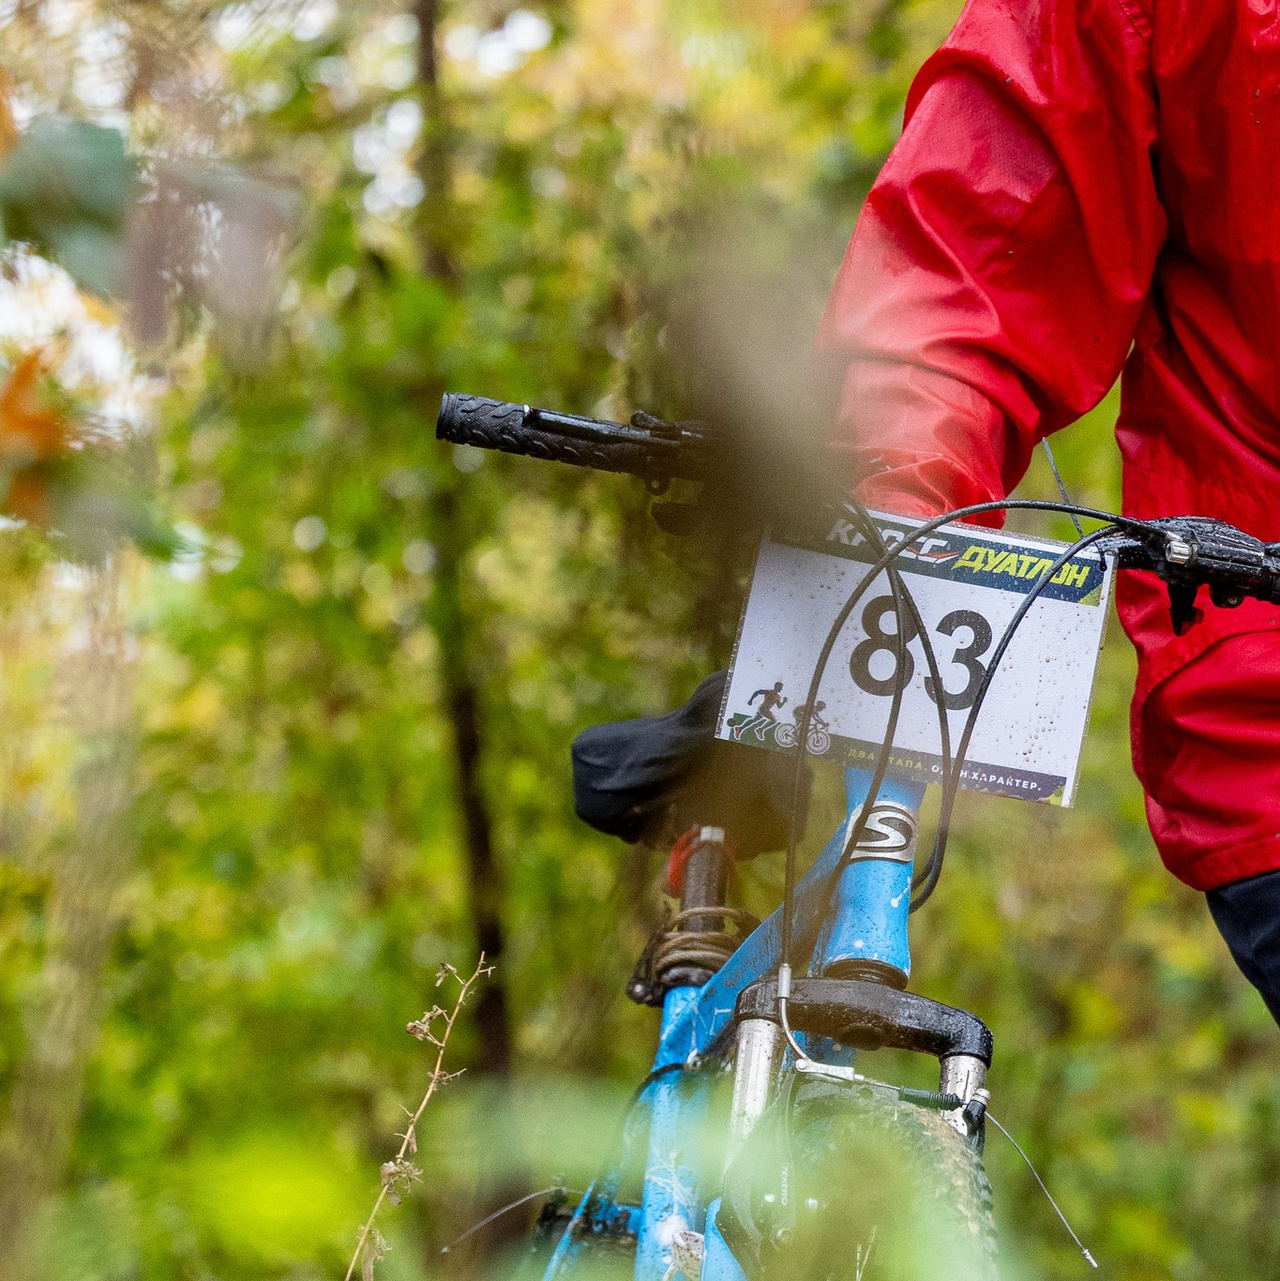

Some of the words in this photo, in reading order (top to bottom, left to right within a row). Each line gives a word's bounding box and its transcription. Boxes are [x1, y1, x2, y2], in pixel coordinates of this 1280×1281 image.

[849, 595, 993, 711] 83
[847, 747, 876, 761] ДВА
[883, 755, 929, 772] ТАПА.
[970, 771, 1042, 792] ХАРАКТЕР.
